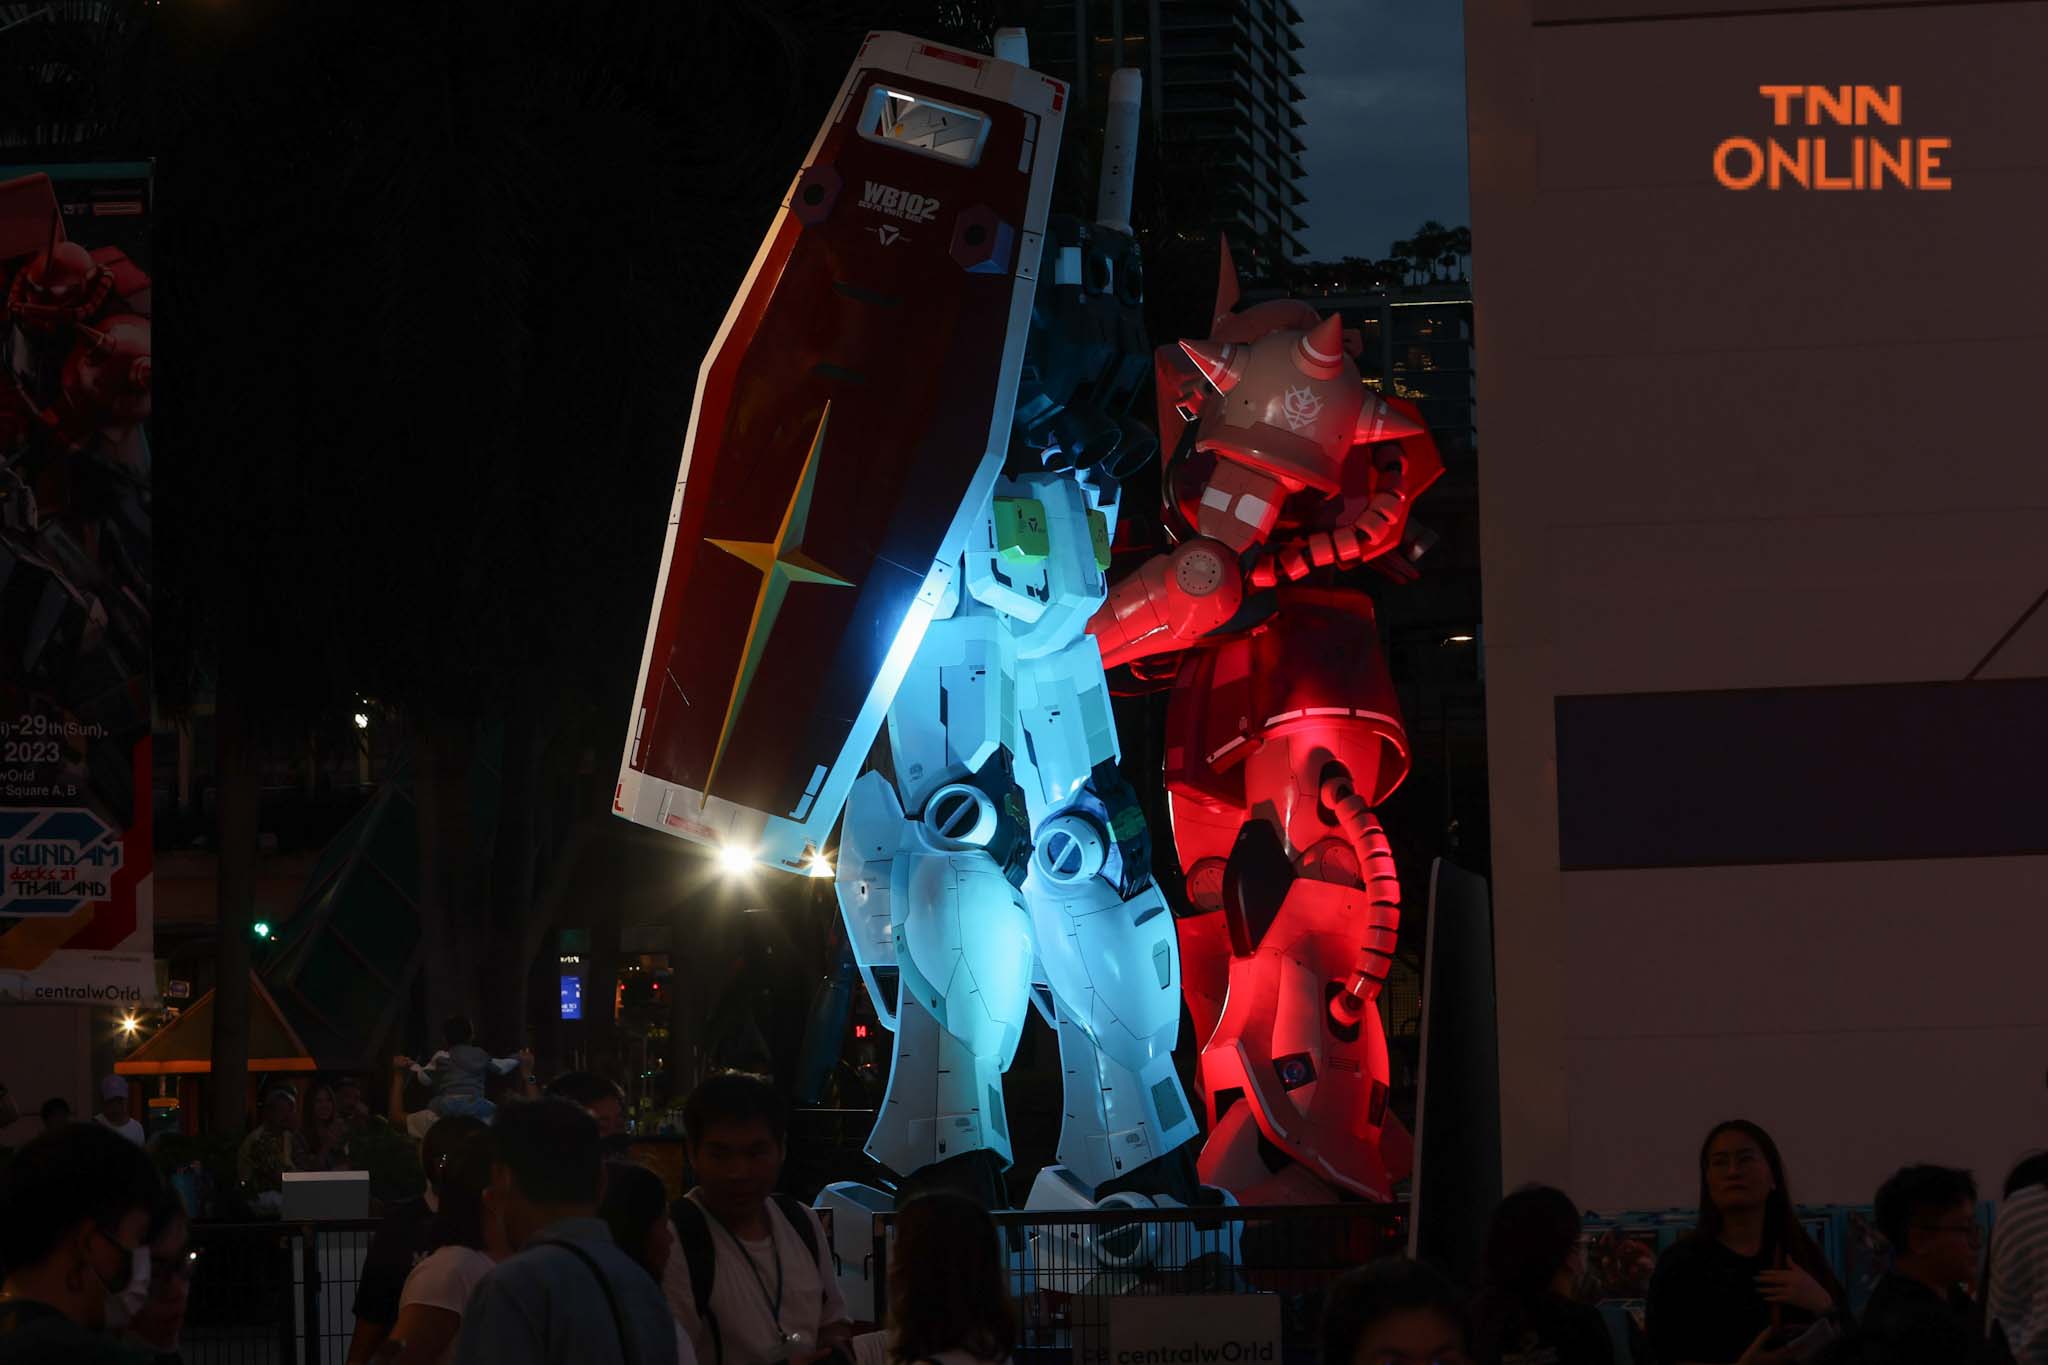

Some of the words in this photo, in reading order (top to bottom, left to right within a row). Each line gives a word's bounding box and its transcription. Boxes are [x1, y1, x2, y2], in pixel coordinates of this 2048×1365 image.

[863, 180, 941, 220] WB102
[4, 742, 61, 763] 2023
[10, 844, 119, 866] GUNDAM
[12, 880, 107, 897] THAILAND
